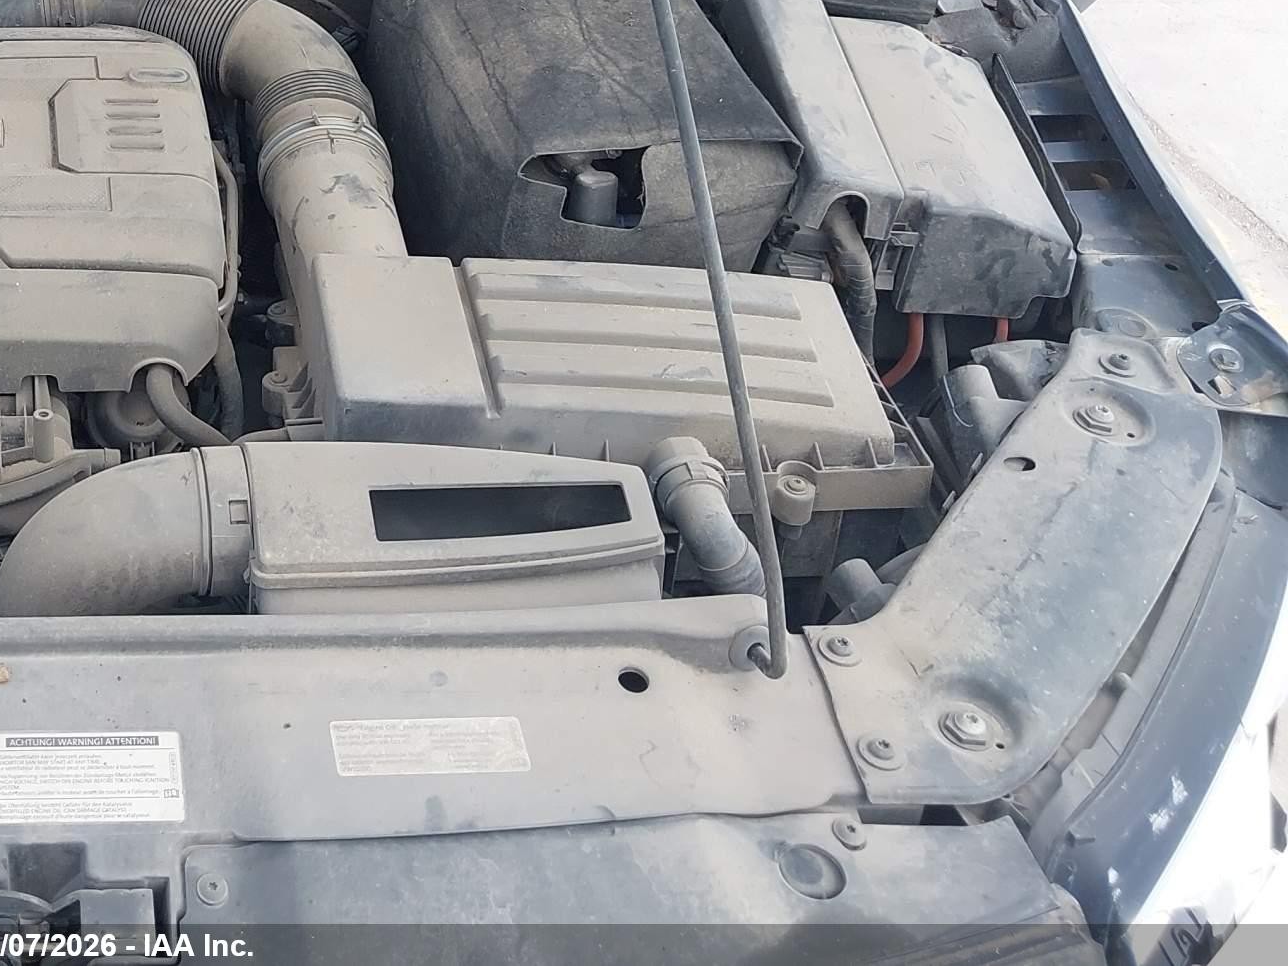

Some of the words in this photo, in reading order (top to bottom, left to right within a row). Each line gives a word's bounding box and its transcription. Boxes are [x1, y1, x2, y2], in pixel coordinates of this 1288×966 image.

[9, 738, 55, 747] ACHTUNG!
[58, 737, 103, 746] WARNING!
[105, 736, 157, 746] ATTENTION!
